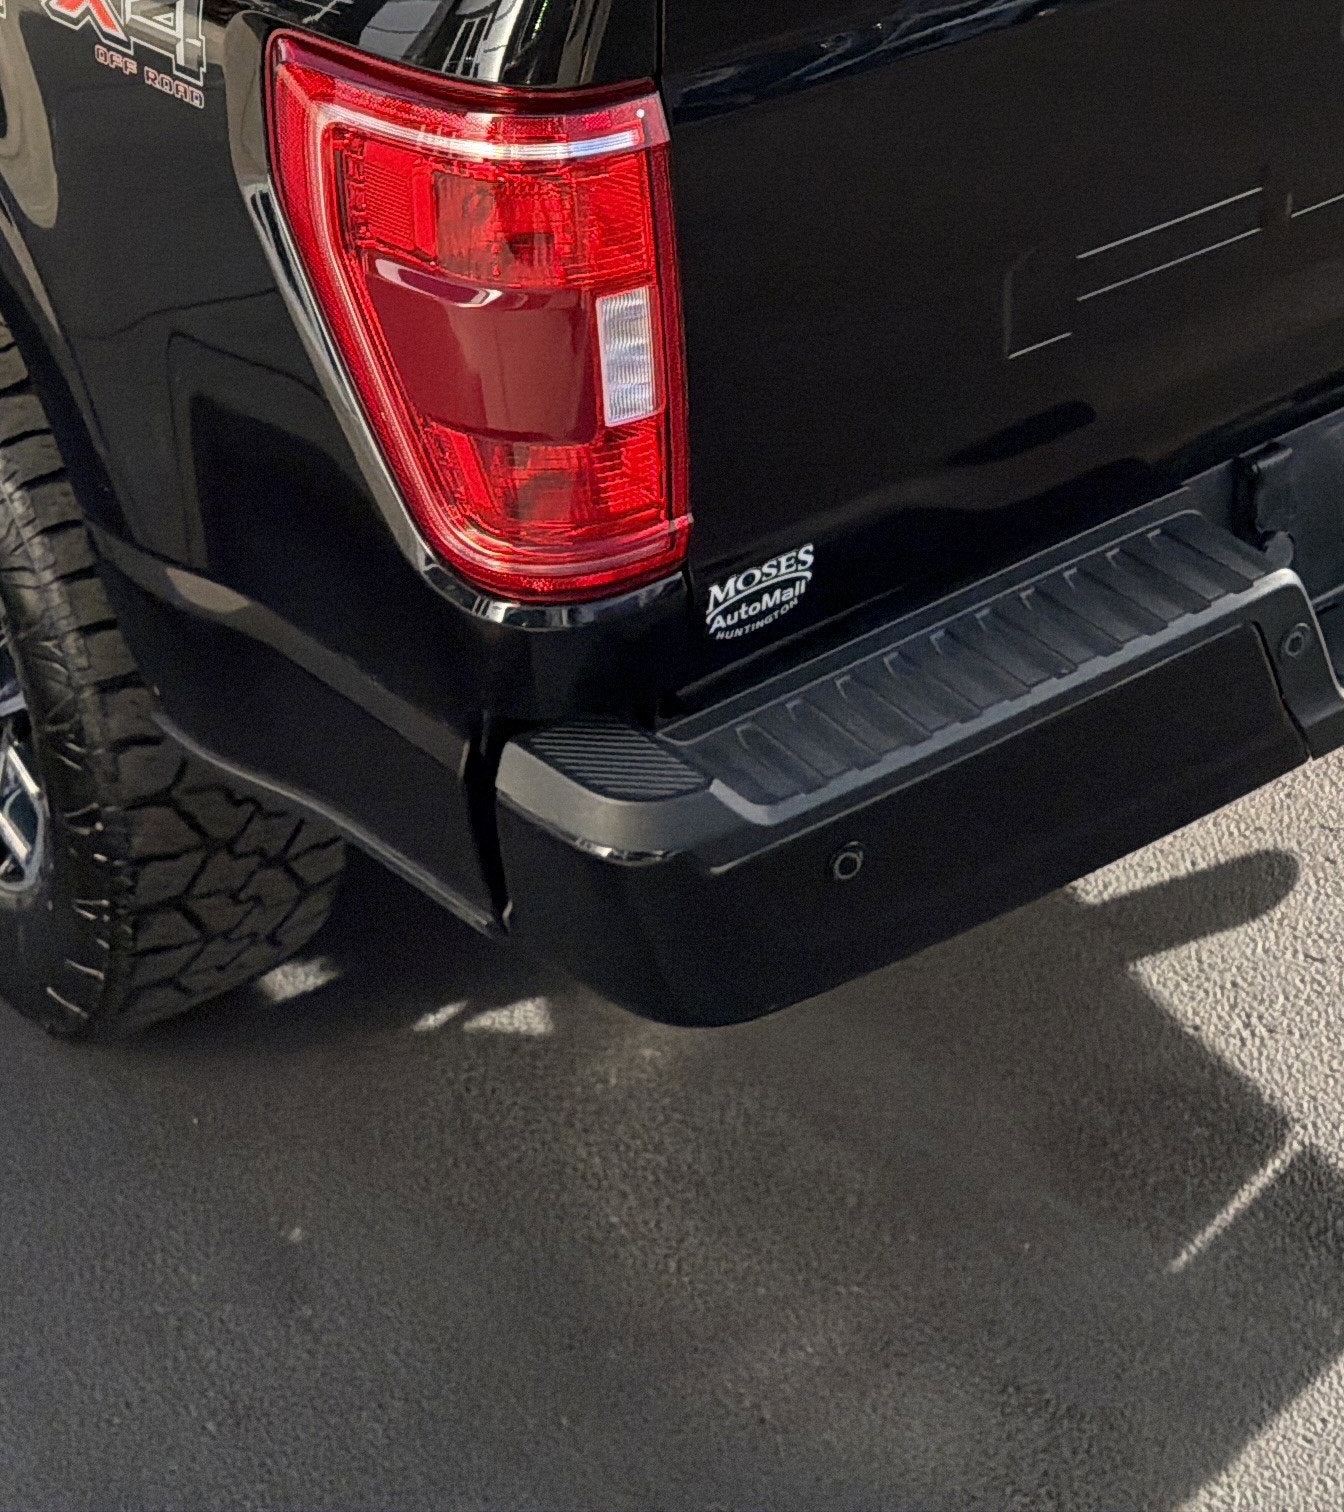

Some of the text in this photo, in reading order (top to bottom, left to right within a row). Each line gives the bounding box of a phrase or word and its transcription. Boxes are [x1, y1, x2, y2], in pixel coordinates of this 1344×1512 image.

[94, 44, 205, 109] OFF ROAD
[705, 542, 815, 616] MOSES
[709, 578, 807, 636] AutoMall
[715, 596, 799, 641] HUNTINGTON
